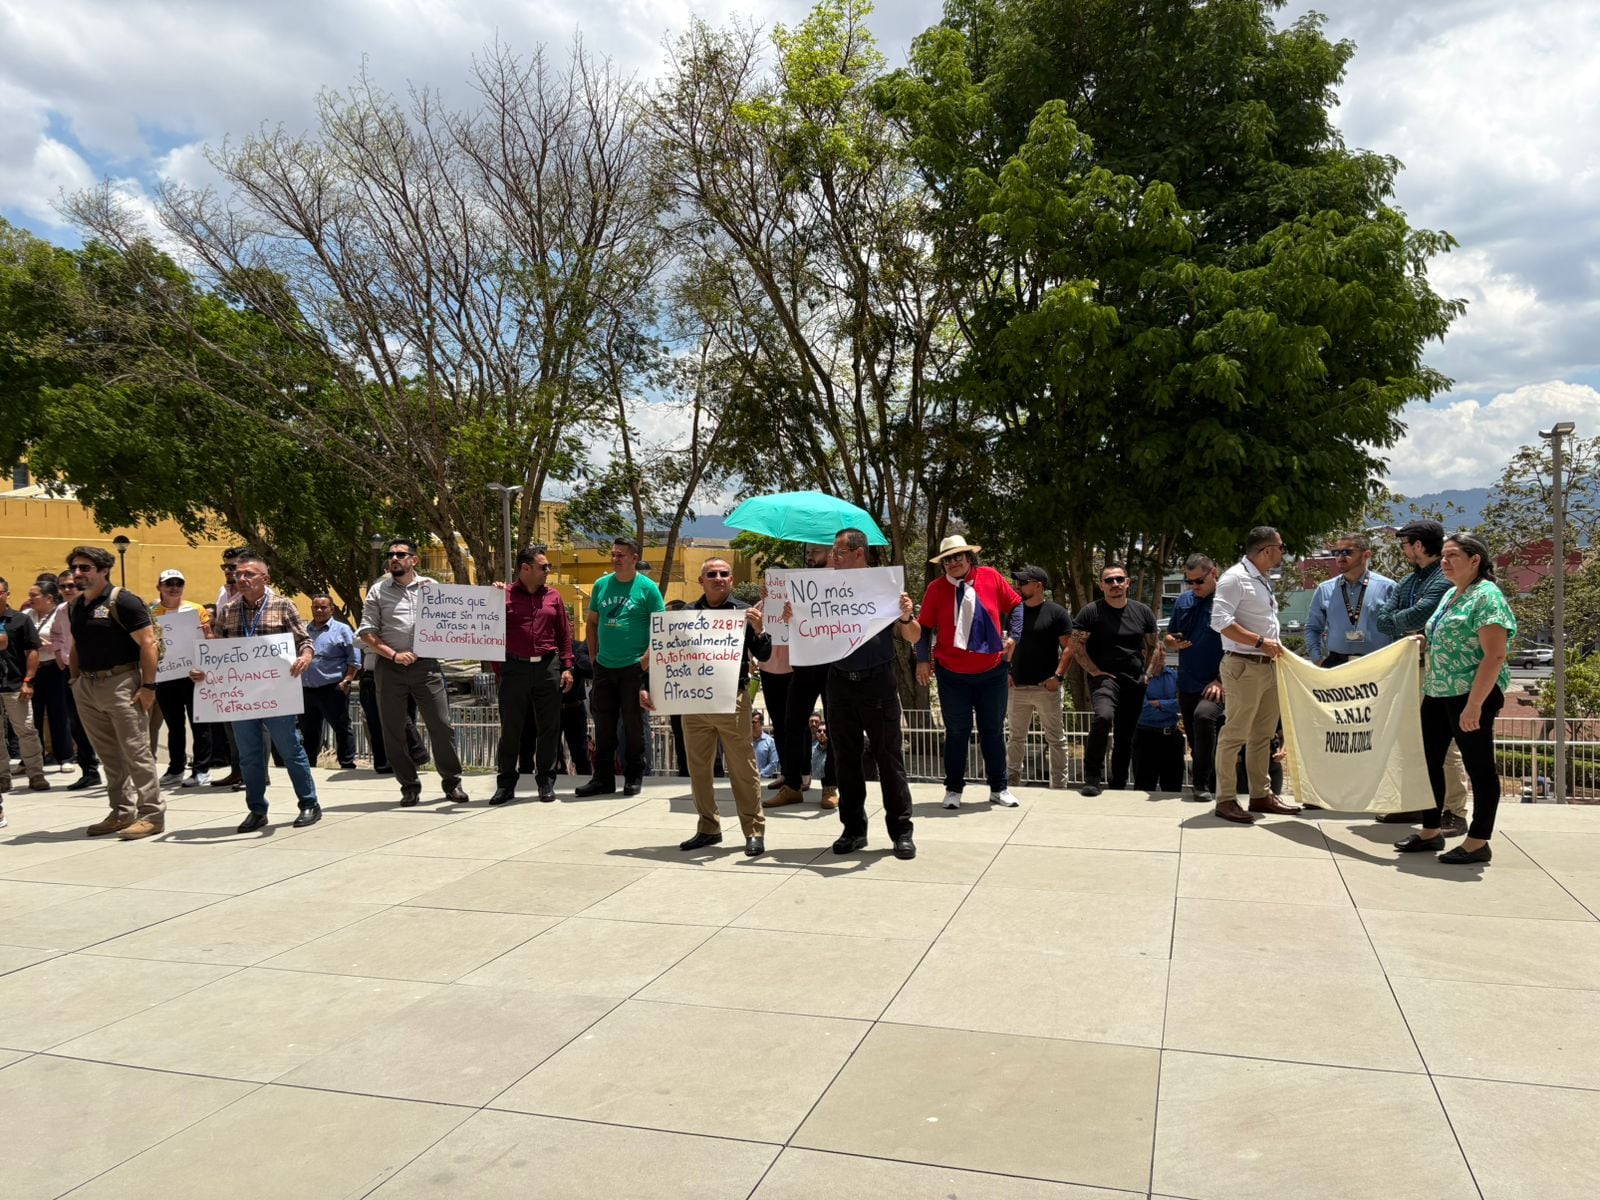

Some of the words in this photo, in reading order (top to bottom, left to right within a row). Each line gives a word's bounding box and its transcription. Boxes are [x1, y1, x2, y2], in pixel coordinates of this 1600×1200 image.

[790, 579, 818, 603] NO
[825, 581, 854, 598] más
[421, 606, 457, 619] AVANCE
[477, 611, 500, 621] más
[652, 616, 664, 634] El
[668, 615, 710, 636] proyecto
[712, 619, 744, 630] 22817
[799, 619, 862, 640] Cumplan
[419, 629, 443, 643] Sala
[445, 631, 505, 646] Constitucional
[652, 638, 664, 651] Es
[666, 633, 739, 648] actuarialmente
[252, 642, 288, 659] 22817
[205, 671, 223, 686] Que
[228, 667, 281, 683] AVANCE
[665, 662, 692, 678] Basta
[697, 662, 715, 676] de
[200, 688, 217, 700] Sin
[221, 686, 244, 698] más
[1312, 682, 1378, 703] SINDICATO
[1326, 731, 1349, 754] PODER
